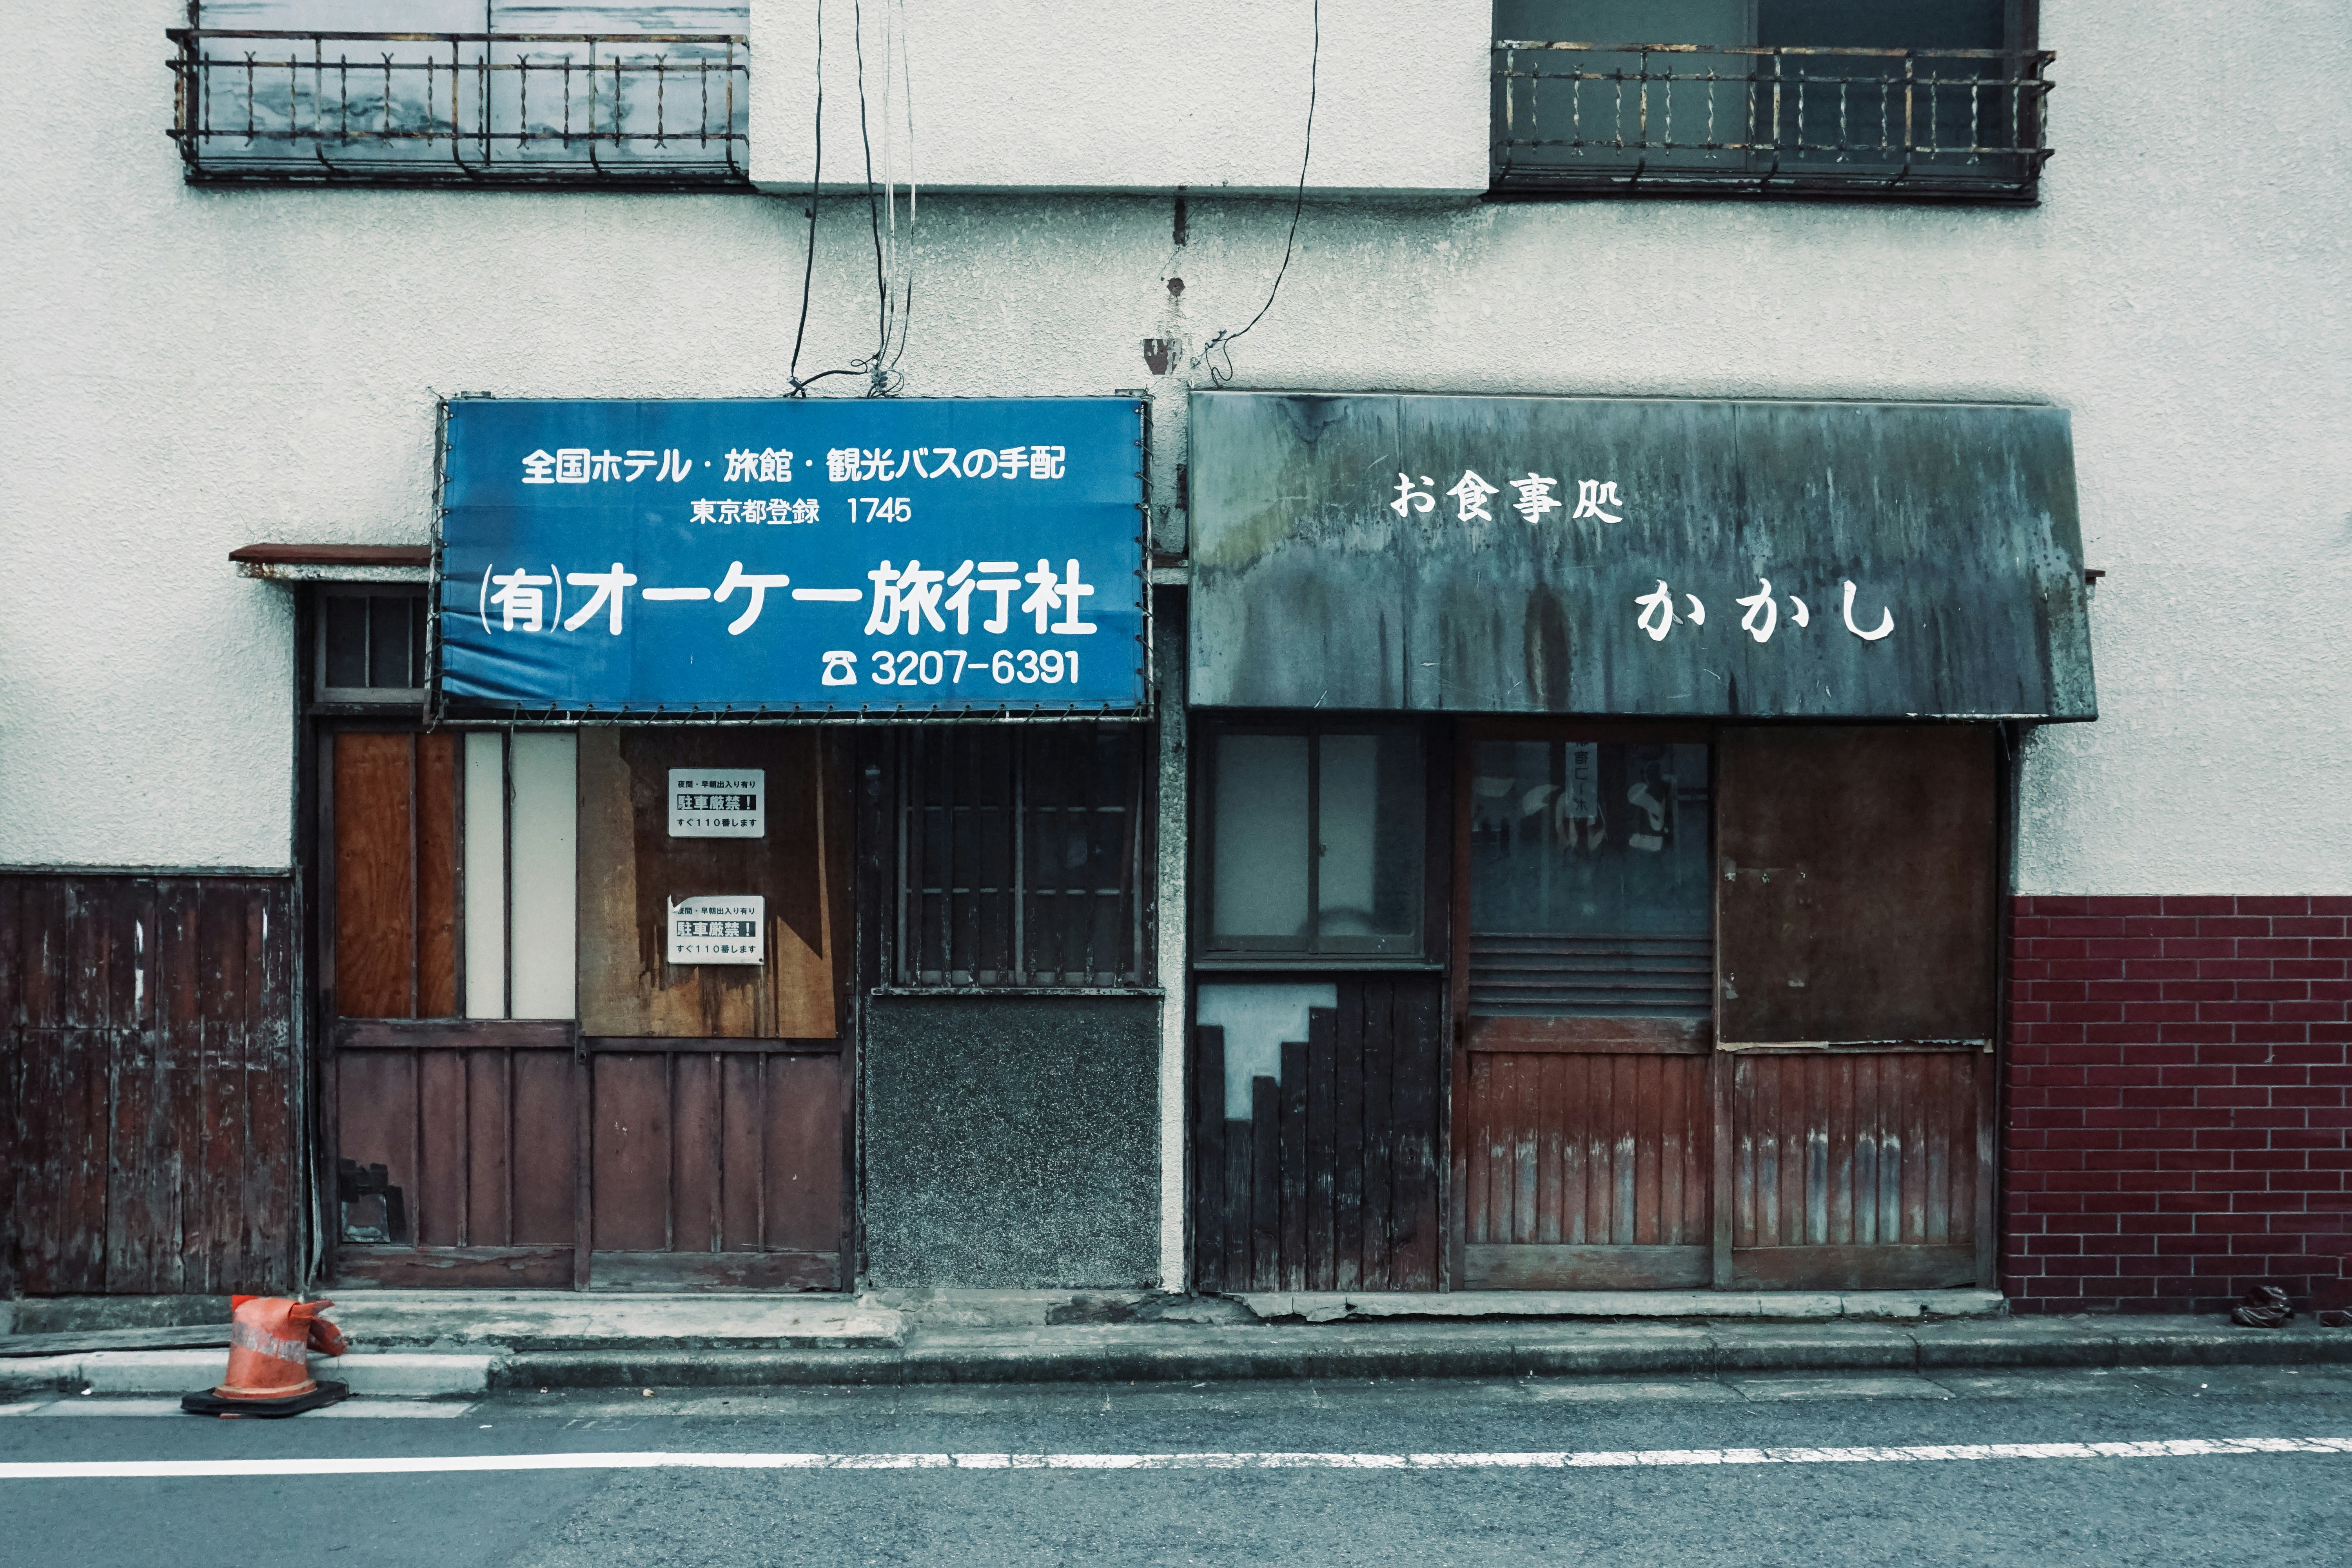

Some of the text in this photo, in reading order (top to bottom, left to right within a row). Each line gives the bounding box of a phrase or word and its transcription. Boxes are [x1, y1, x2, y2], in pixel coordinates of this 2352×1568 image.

[691, 497, 911, 524] 東京都登録 1745
[1390, 470, 1622, 523] お食事処
[1635, 578, 1894, 642] かかし
[872, 650, 1078, 685] 3207-6391
